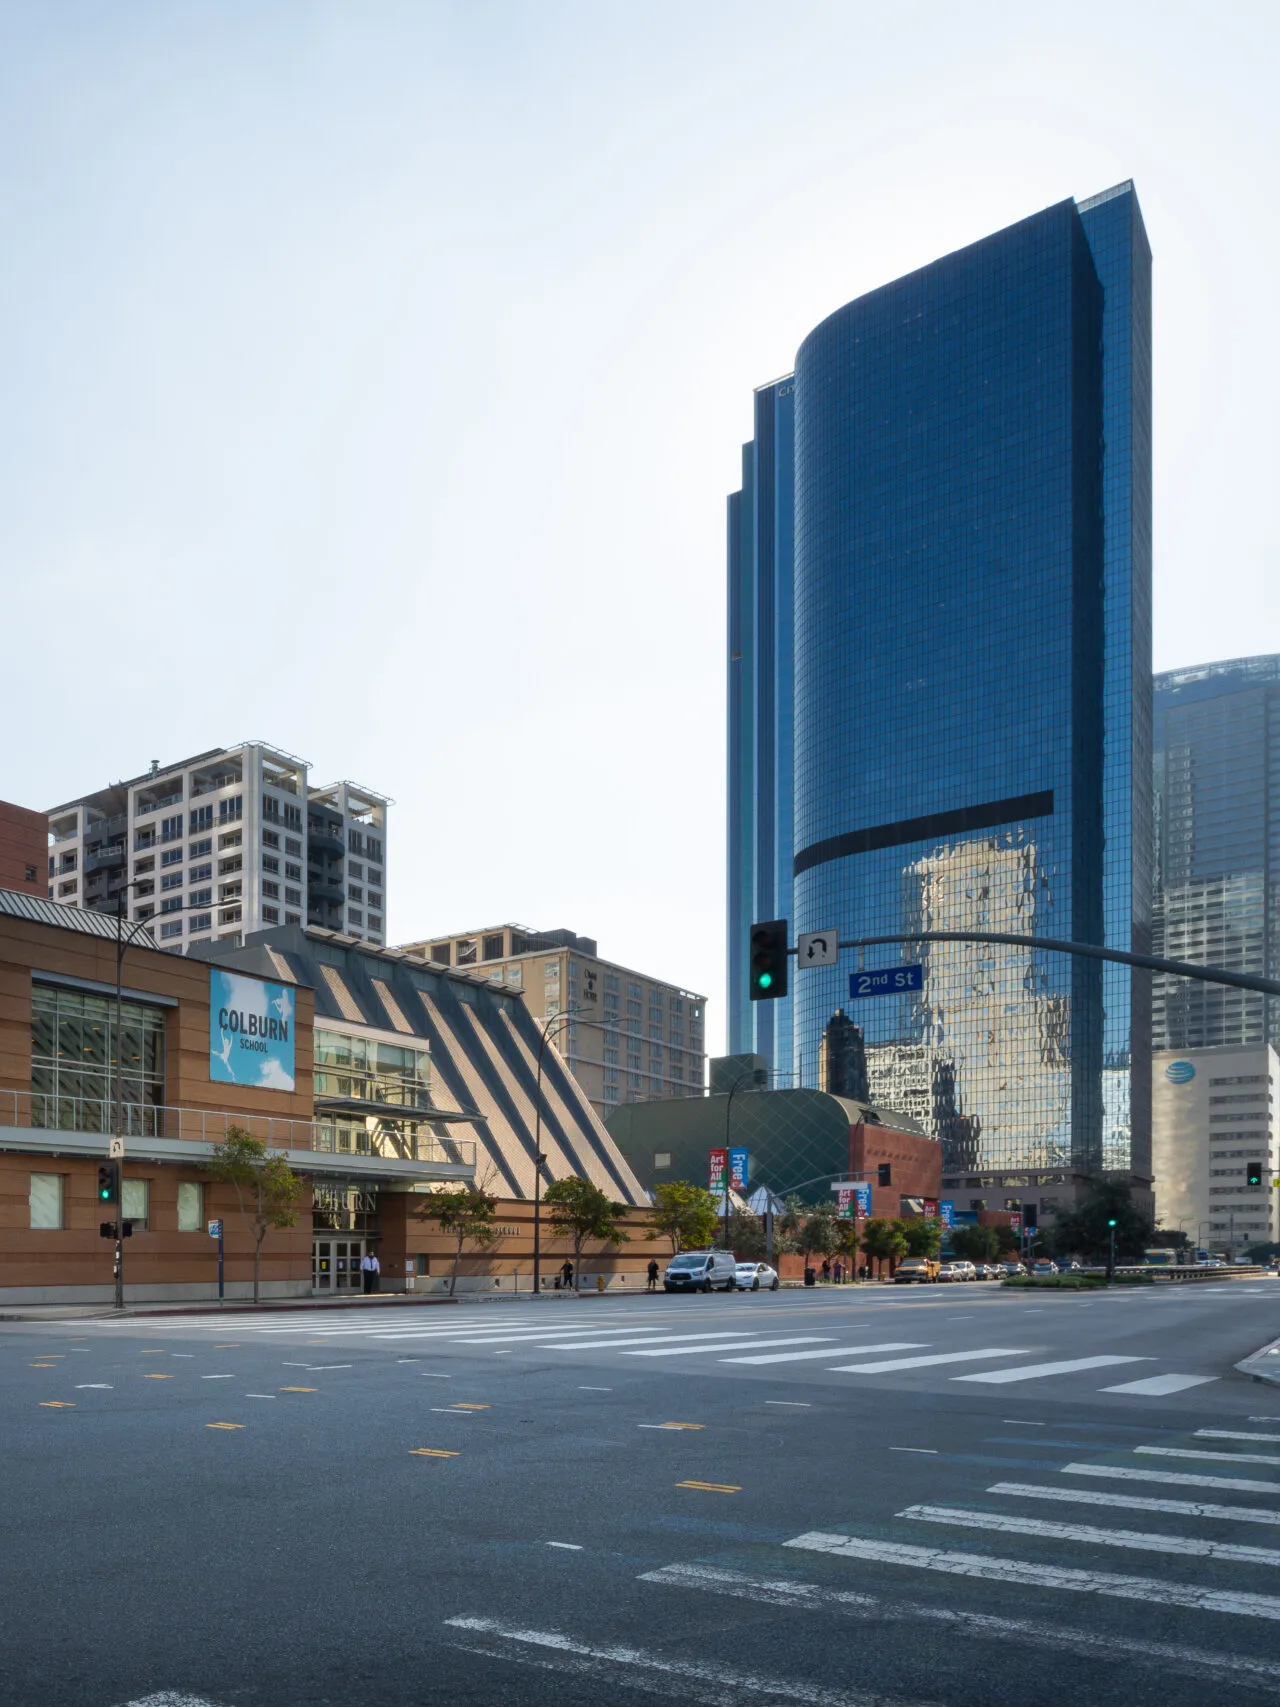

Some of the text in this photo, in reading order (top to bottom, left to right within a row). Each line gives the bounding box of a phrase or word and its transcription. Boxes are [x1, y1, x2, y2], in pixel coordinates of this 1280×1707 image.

[858, 972, 914, 994] 2nd St
[218, 1007, 289, 1043] COLBURN
[240, 1038, 269, 1054] SCHOOL
[710, 1155, 724, 1164] Art
[732, 1154, 746, 1180] Free
[710, 1164, 724, 1172] for
[710, 1172, 722, 1181] All
[839, 1189, 851, 1197] Art
[858, 1189, 870, 1210] Free
